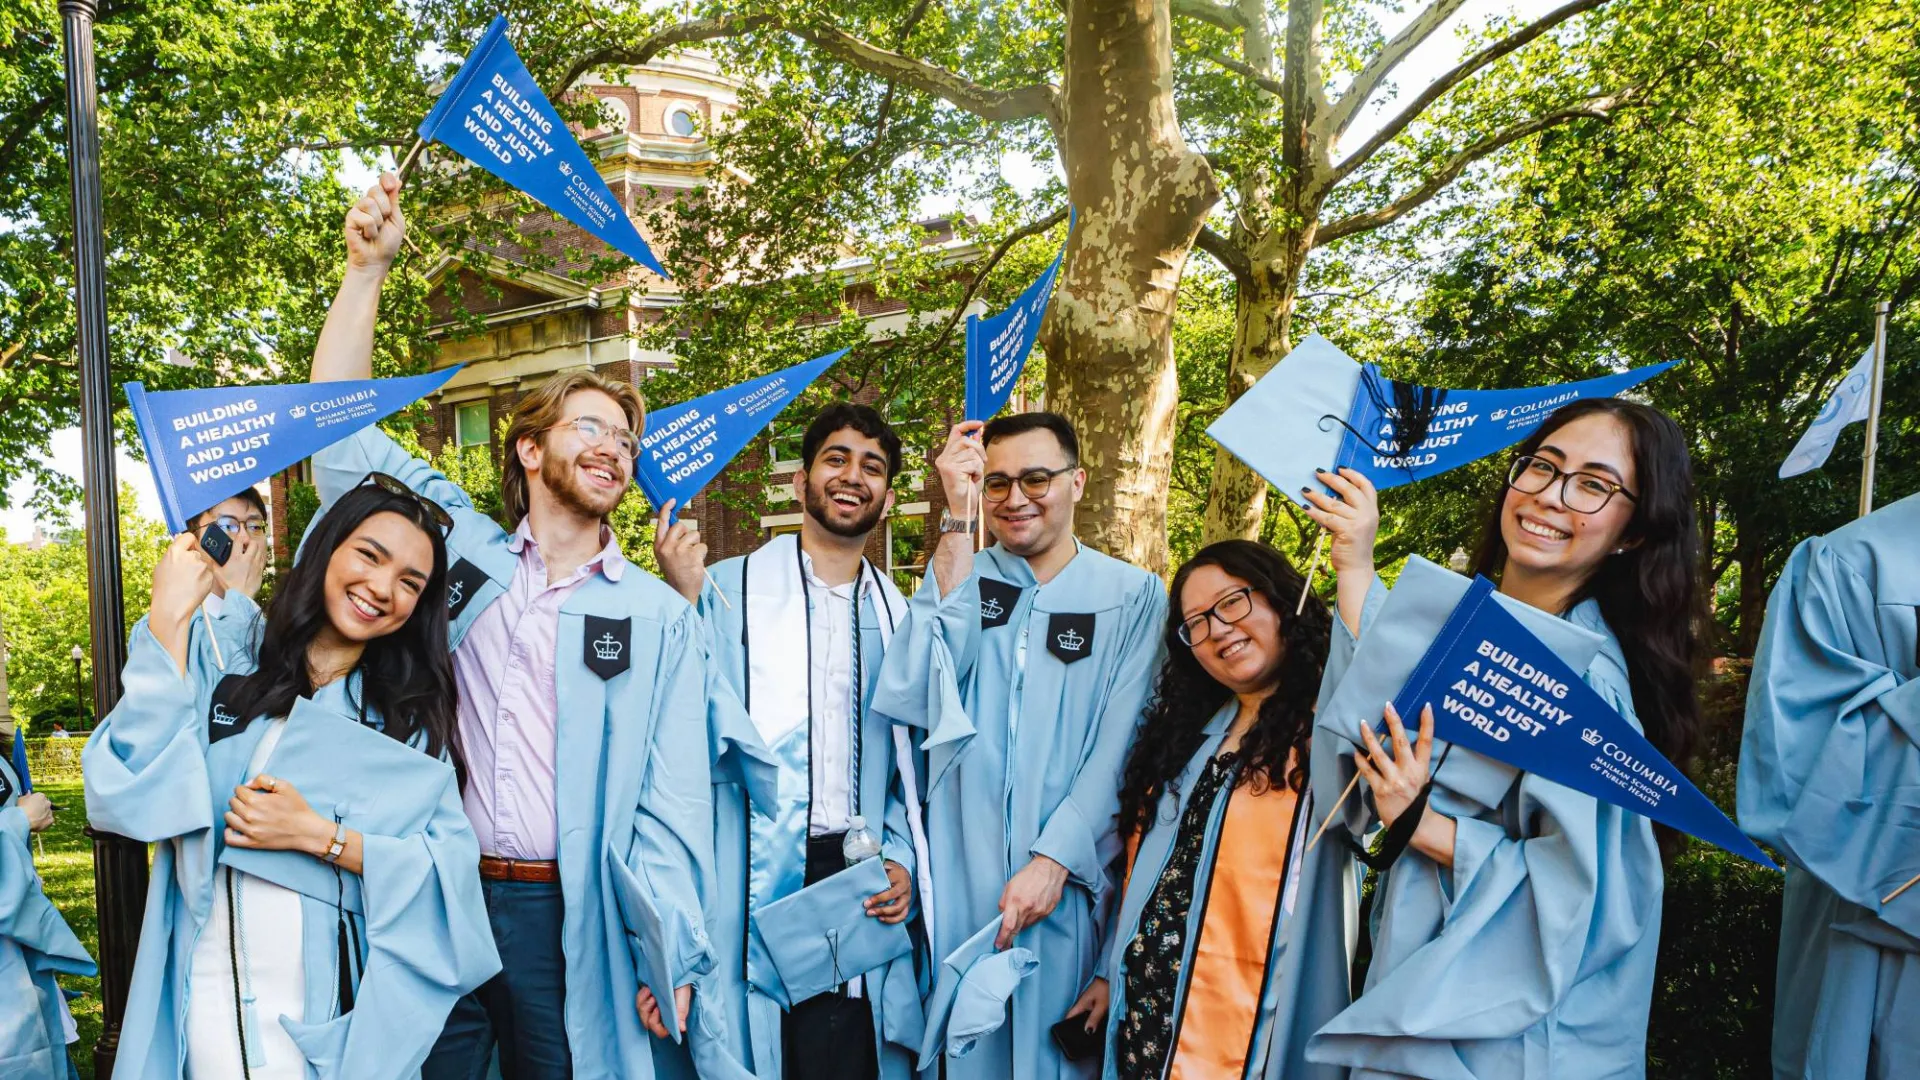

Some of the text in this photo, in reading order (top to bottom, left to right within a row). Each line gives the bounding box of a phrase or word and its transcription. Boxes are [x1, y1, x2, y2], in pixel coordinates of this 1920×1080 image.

[481, 89, 554, 157] A HEALTHY
[491, 73, 552, 135] BUILDING
[463, 115, 513, 164] WORLD
[471, 103, 538, 164] AND JUST
[572, 174, 617, 222] COLUMBIA
[990, 306, 1023, 352] BUILDING
[990, 313, 1028, 367] A HEALTHY
[990, 334, 1024, 381] AND JUST
[990, 360, 1018, 395] WORLD
[310, 388, 378, 413] COLUMBIA
[315, 402, 374, 422] MAILMAN SCHOOL
[738, 377, 786, 406] COLUMBIA
[1510, 390, 1579, 416] COLUMBIA
[172, 399, 258, 432] BUILDING
[180, 412, 277, 450] A HEALTHY
[327, 416, 350, 425] PUBLIC
[351, 407, 377, 418] HEALTH
[641, 409, 700, 449] BUILDING
[1379, 423, 1393, 435] A
[1508, 413, 1540, 425] MAILMAN
[1517, 417, 1541, 428] PUBLIC
[186, 432, 271, 467] AND JUST
[652, 414, 717, 461] A HEALTHY
[660, 431, 719, 473] AND JUST
[1376, 433, 1462, 452] AN JUST
[190, 456, 258, 485] WORLD
[667, 452, 715, 485] WORLD
[1373, 453, 1437, 469] WORLD
[1476, 639, 1570, 700] BUILDING
[1451, 678, 1547, 738] AND JUST
[1464, 660, 1574, 728] A HEALTHY
[1443, 695, 1511, 743] WORLD
[1590, 763, 1658, 807] OF PUBLIC HEALTH
[1594, 756, 1661, 800] MAILMAN SCHOOL
[1602, 742, 1678, 796] COLUMBIA
